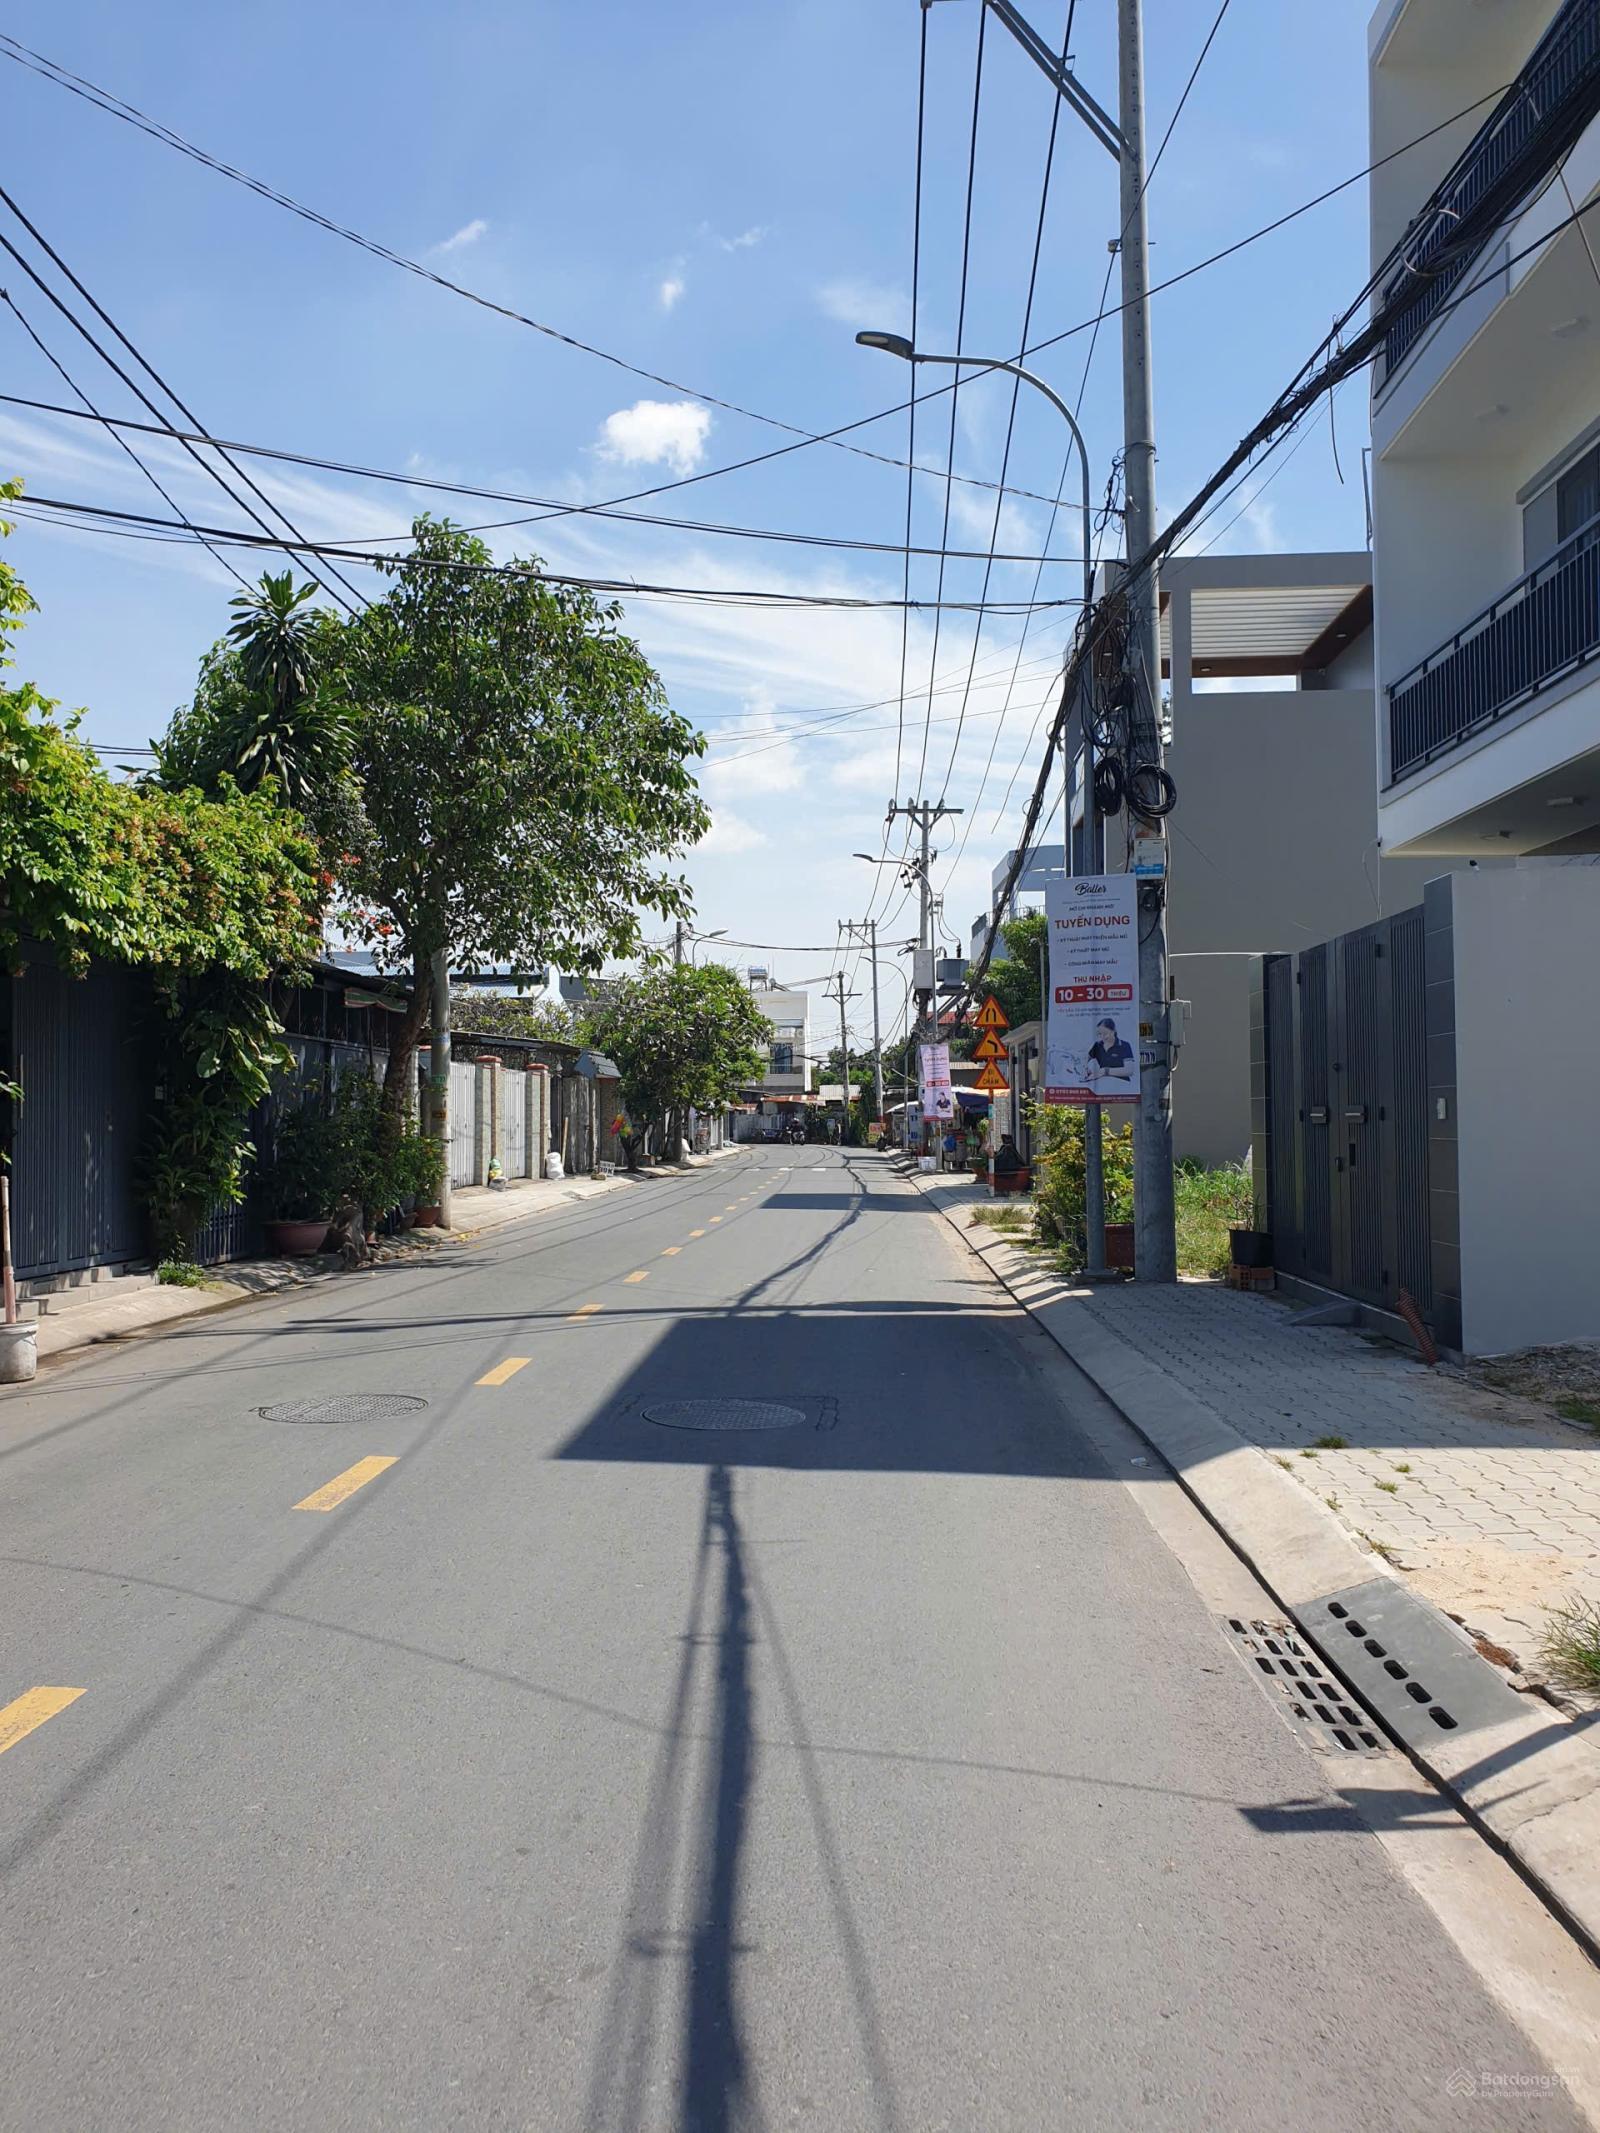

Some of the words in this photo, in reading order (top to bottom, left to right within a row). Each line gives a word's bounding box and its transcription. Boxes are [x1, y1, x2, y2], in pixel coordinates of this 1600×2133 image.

[1055, 913, 1091, 929] TUYỂN
[1094, 915, 1130, 928] DỤNG
[1089, 974, 1112, 983] NHẬP
[1058, 989, 1073, 1001] 10
[1087, 987, 1104, 999] 30
